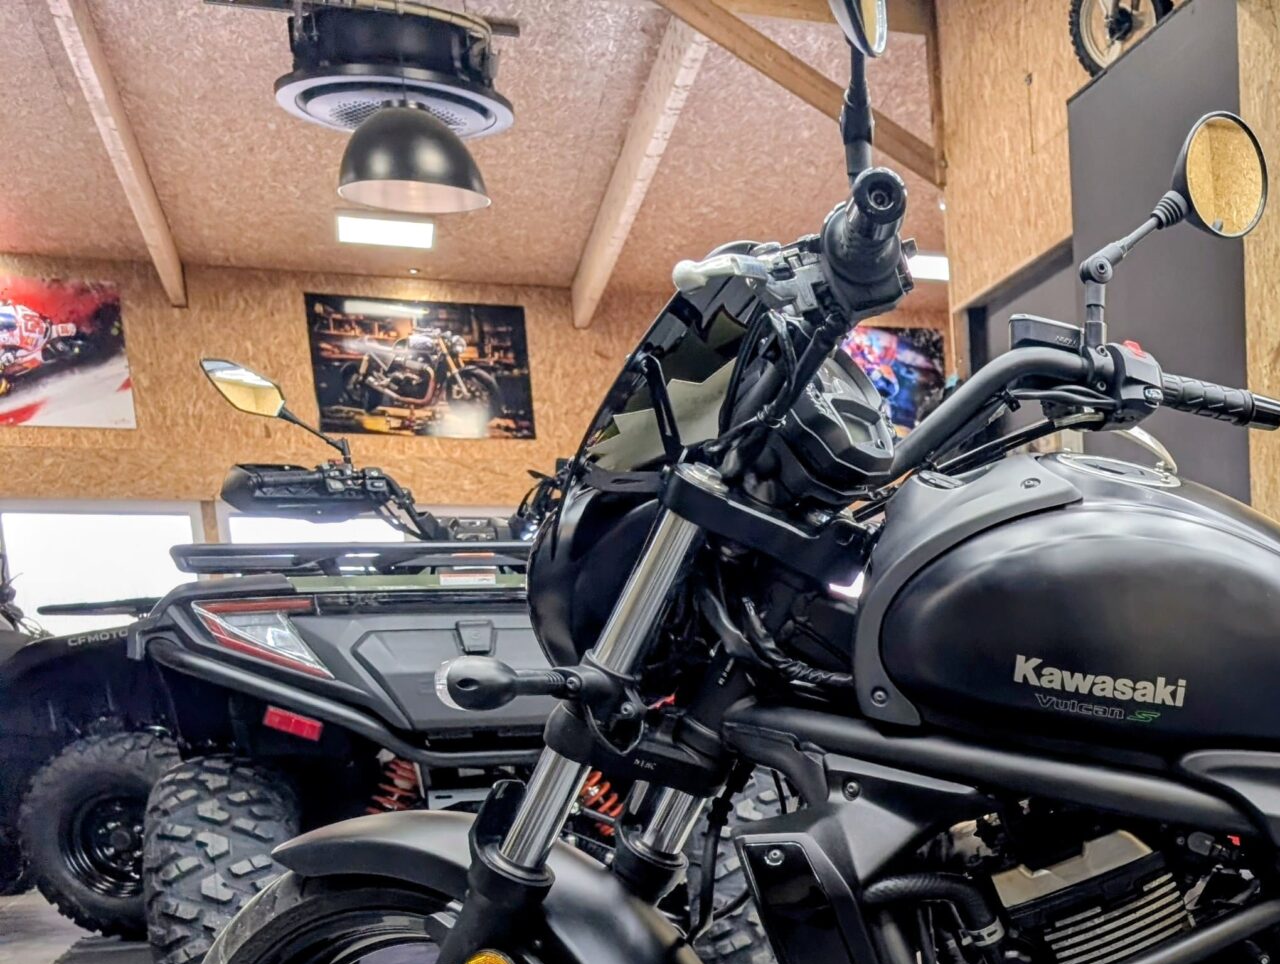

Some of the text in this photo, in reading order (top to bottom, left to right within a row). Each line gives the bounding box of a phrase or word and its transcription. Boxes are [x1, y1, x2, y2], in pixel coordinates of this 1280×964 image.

[67, 628, 129, 647] CFMOTO
[1013, 654, 1187, 708] Kawasaki
[1034, 692, 1161, 723] Vulcan S
